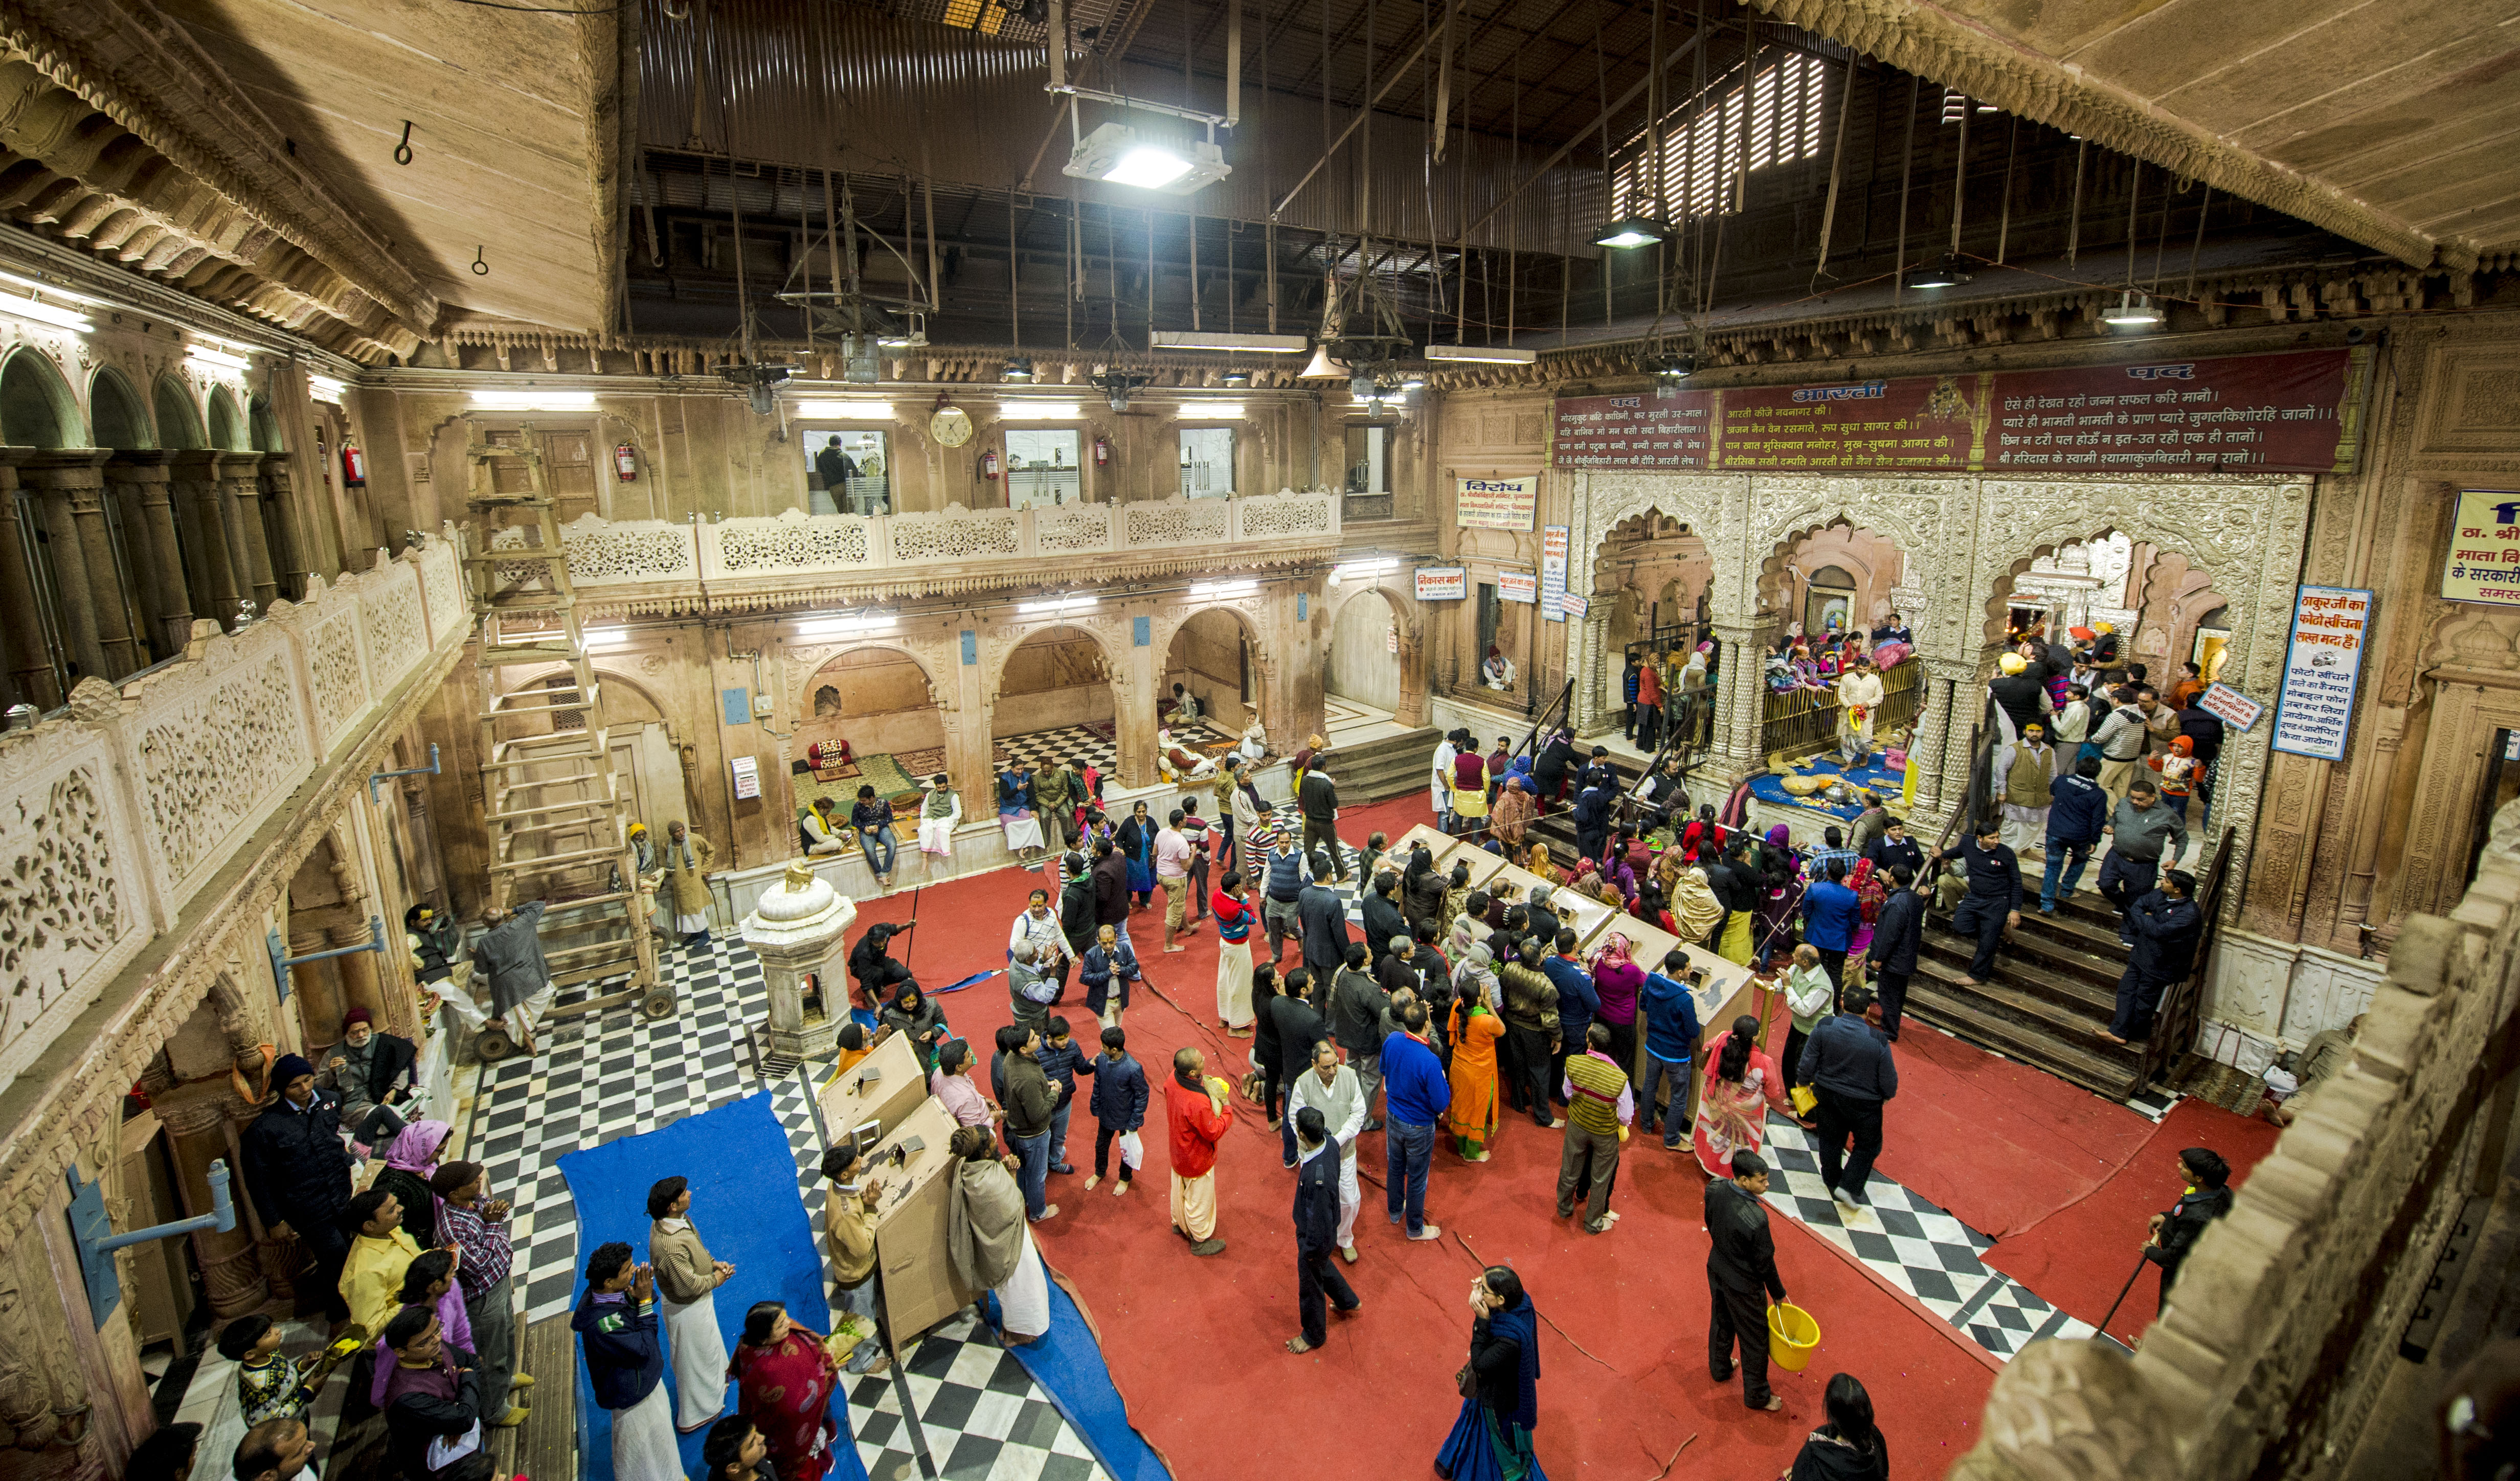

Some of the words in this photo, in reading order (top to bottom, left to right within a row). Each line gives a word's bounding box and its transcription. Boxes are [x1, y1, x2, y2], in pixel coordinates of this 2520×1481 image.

[2125, 364, 2195, 380] पद
[1792, 380, 1887, 402] आरती
[1610, 397, 1640, 407] पद
[2005, 397, 2021, 410] ऐसे
[2024, 396, 2035, 409] ही
[2038, 396, 2064, 408] देखत
[2089, 396, 2115, 406] जन्म
[2119, 394, 2151, 405] सफल
[2155, 389, 2178, 403] करि
[1561, 413, 1587, 424] मोरमुकुट
[1590, 412, 1602, 421] कटि
[1649, 408, 1668, 421] मुरली
[1728, 407, 1751, 418] आरती
[1754, 406, 1772, 417] कीजै
[1776, 408, 1811, 417] नवनागर
[2002, 415, 2024, 428] प्यारे
[2028, 415, 2038, 428] ही
[2042, 413, 2074, 426] भामती
[2079, 412, 2113, 425] भामती
[2118, 411, 2128, 424] के
[2132, 414, 2155, 425] प्राण
[2159, 409, 2186, 423] प्यारे
[1560, 427, 1570, 437] यहि
[1574, 427, 1593, 436] बानिक
[1598, 426, 1605, 435] मो
[1751, 423, 1765, 434] नैन
[1841, 423, 1860, 435] सुधा
[1864, 422, 1891, 430] सागर
[2001, 433, 2019, 446] छिन
[2023, 437, 2031, 445] न
[2056, 435, 2073, 445] पल
[2077, 431, 2101, 445] होऊँ
[2102, 435, 2111, 444] न
[2184, 432, 2205, 444] एक
[2209, 428, 2221, 443] ही
[1574, 441, 1585, 450] बनी
[1589, 443, 1606, 452] पटुका
[1764, 439, 1804, 453] मुसिक्यात
[1559, 455, 1564, 464] जै
[1566, 455, 1571, 464] जै
[1630, 455, 1639, 465] की
[1641, 455, 1654, 465] दौरि
[1657, 455, 1678, 465] आरती
[1725, 455, 1756, 466] श्रीरसिक
[1759, 455, 1778, 466] सखी
[1781, 455, 1807, 466] दम्पति
[1810, 455, 1837, 466] आरती
[1856, 454, 1873, 465] नैन
[1876, 454, 1894, 465] सैन
[1999, 451, 2010, 464] श्री
[2013, 450, 2049, 464] हरिदास
[2053, 450, 2063, 463] के
[2066, 450, 2097, 463] स्वामी
[2196, 453, 2217, 463] मन
[1466, 480, 1524, 491] विरोध
[2456, 550, 2497, 562] माता
[2452, 562, 2466, 579] के
[2470, 566, 2520, 583] सरकारी
[1418, 575, 1445, 585] निकास
[1446, 574, 1462, 584] मार्ग
[2302, 597, 2331, 610] ठाकुर
[2331, 597, 2348, 609] जी
[2349, 601, 2367, 610] का
[2300, 611, 2324, 626] फोटो
[2291, 668, 2315, 676] फोटो
[2318, 671, 2351, 681] खींचने
[2214, 686, 2235, 699] केवल
[2287, 689, 2323, 701] मोबाइल
[2326, 695, 2347, 704] फोन
[2283, 700, 2303, 709] जब्त
[2321, 704, 2345, 715] लिया
[2282, 711, 2313, 721] जायेगा
[2316, 717, 2343, 726] आर्थिक
[2280, 731, 2301, 740] किया
[2303, 725, 2340, 737] आरोपित
